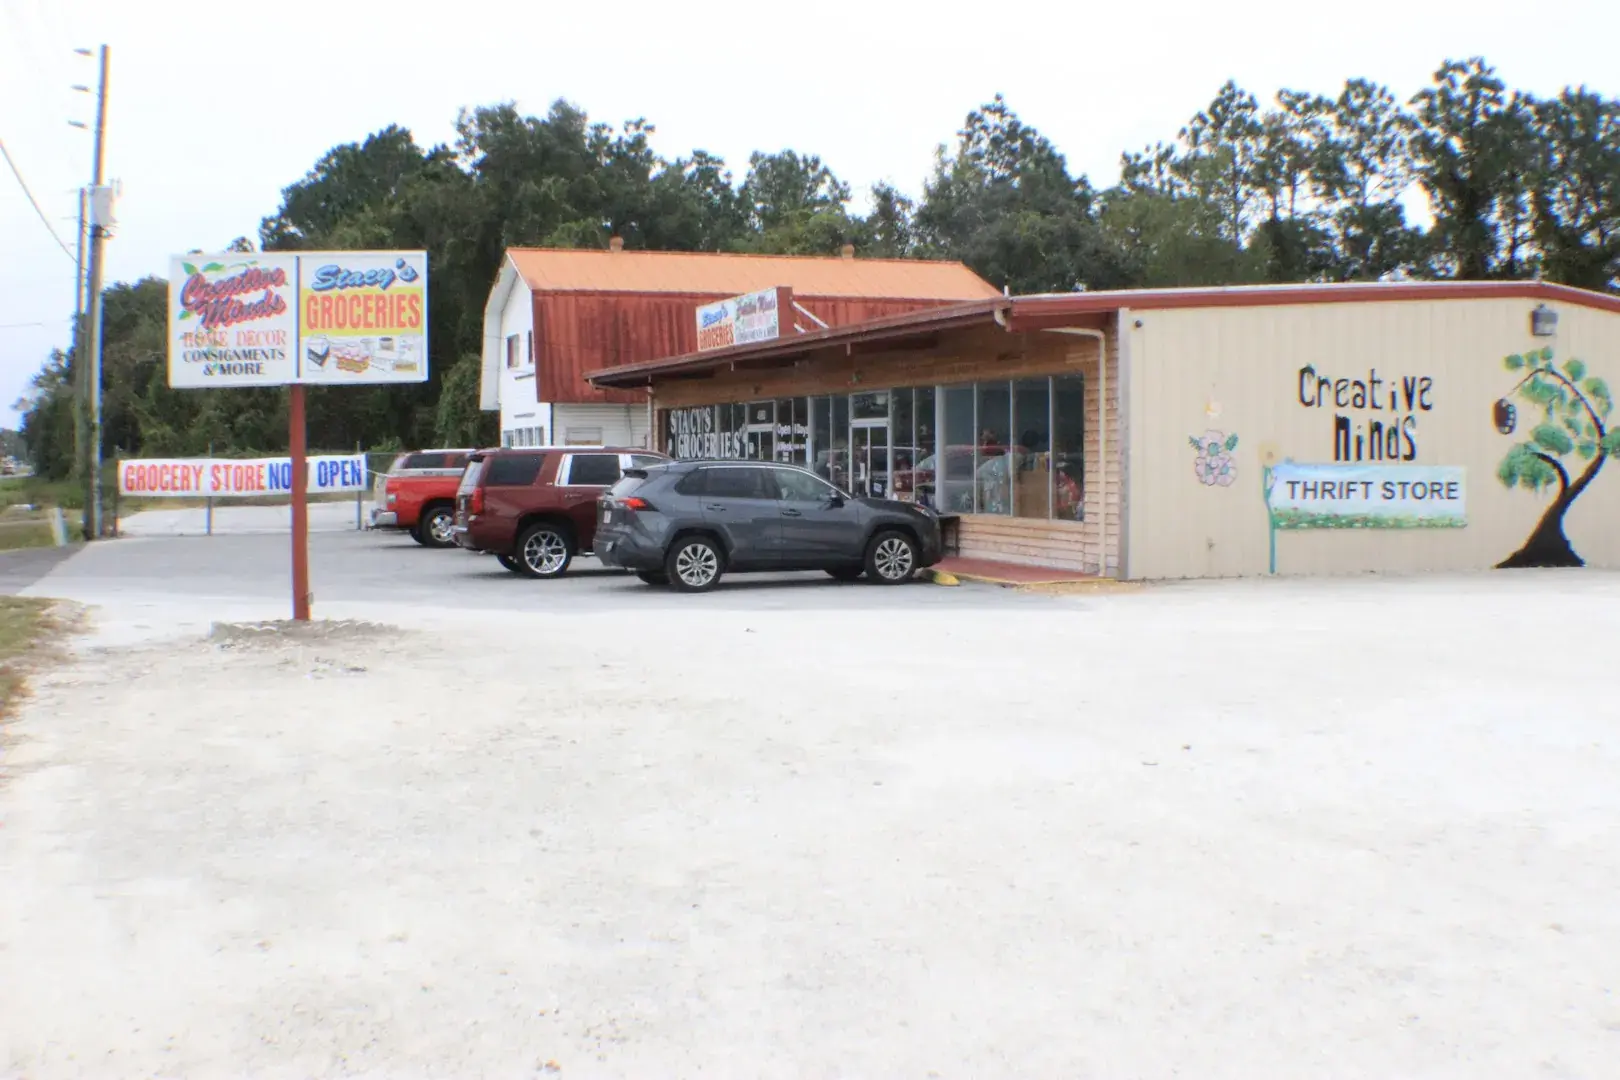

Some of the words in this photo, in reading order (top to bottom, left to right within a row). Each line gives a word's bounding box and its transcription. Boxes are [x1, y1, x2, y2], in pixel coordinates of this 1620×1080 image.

[311, 258, 419, 291] Stacy's
[200, 288, 286, 329] Minds
[306, 293, 420, 330] GROCERIES
[236, 328, 286, 346] DECOR
[182, 348, 286, 363] CONSIGNMENTS
[219, 362, 266, 375] MORE
[1298, 364, 1433, 412] Creative
[670, 407, 712, 434] STACY'S
[678, 431, 740, 458] GROCERIES
[124, 464, 204, 491] GROCERY
[210, 464, 265, 491] STORE
[317, 459, 362, 487] OPEN
[1286, 481, 1374, 500] THRIFT
[1381, 481, 1460, 501] STORE
